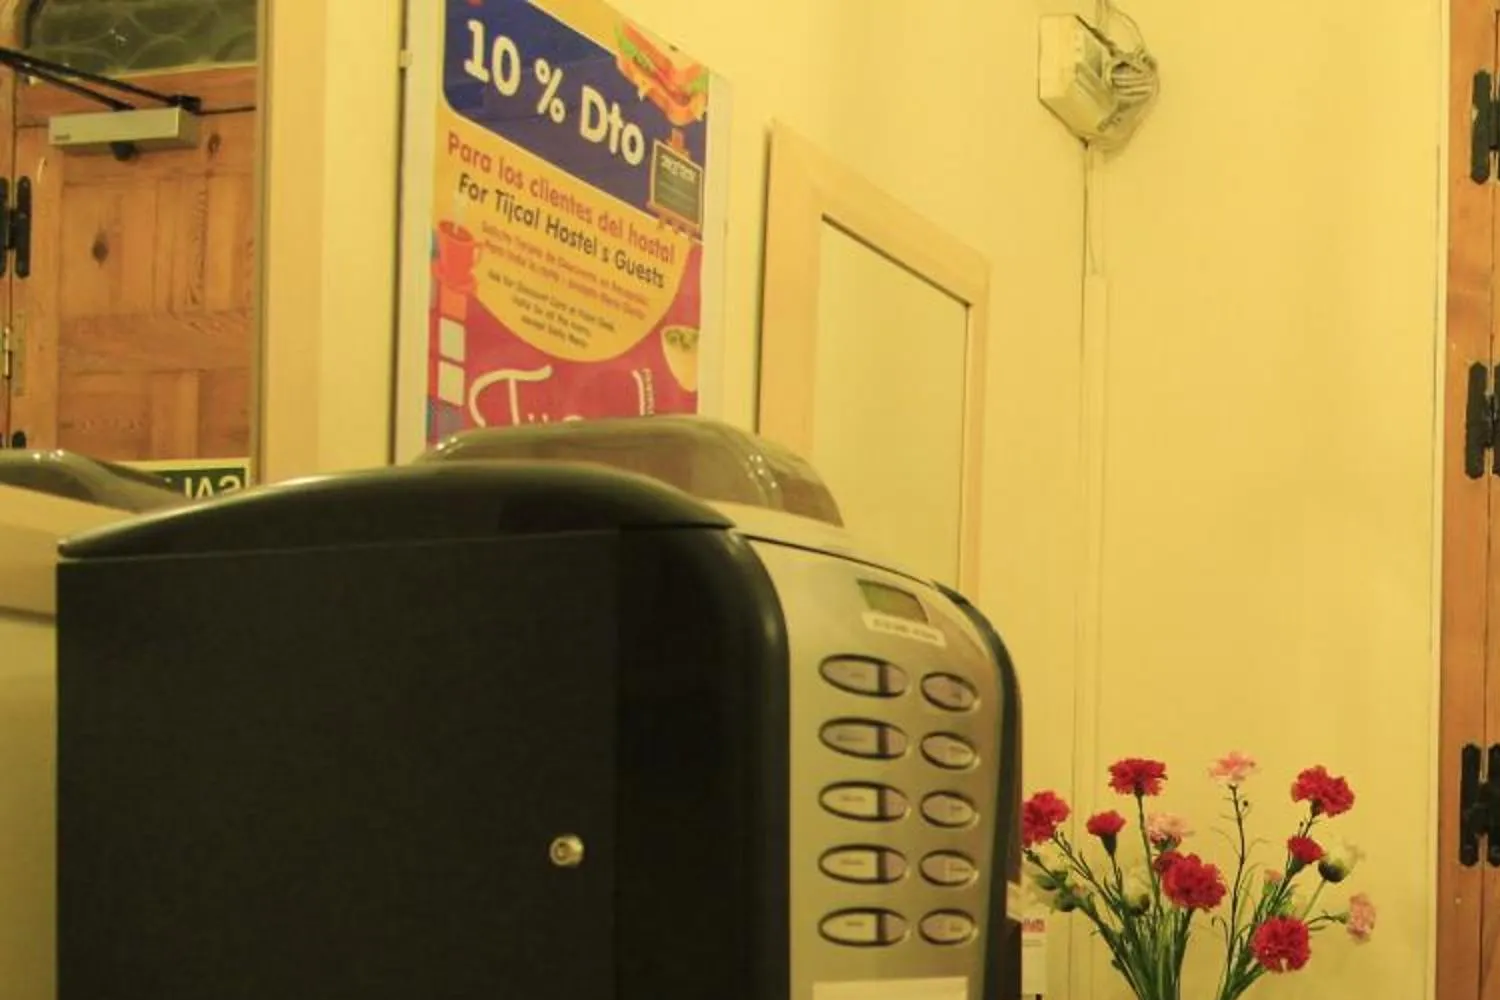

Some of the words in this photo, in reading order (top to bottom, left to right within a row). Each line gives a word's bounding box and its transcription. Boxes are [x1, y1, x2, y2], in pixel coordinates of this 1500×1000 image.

[464, 19, 521, 96] 10
[535, 59, 566, 124] %
[580, 85, 645, 166] Dto
[447, 130, 492, 173] Para
[498, 154, 524, 191] los
[529, 176, 592, 223] clientes
[598, 211, 623, 241] del
[628, 222, 675, 265] hostal
[458, 172, 488, 204] For
[614, 249, 665, 289] Guests
